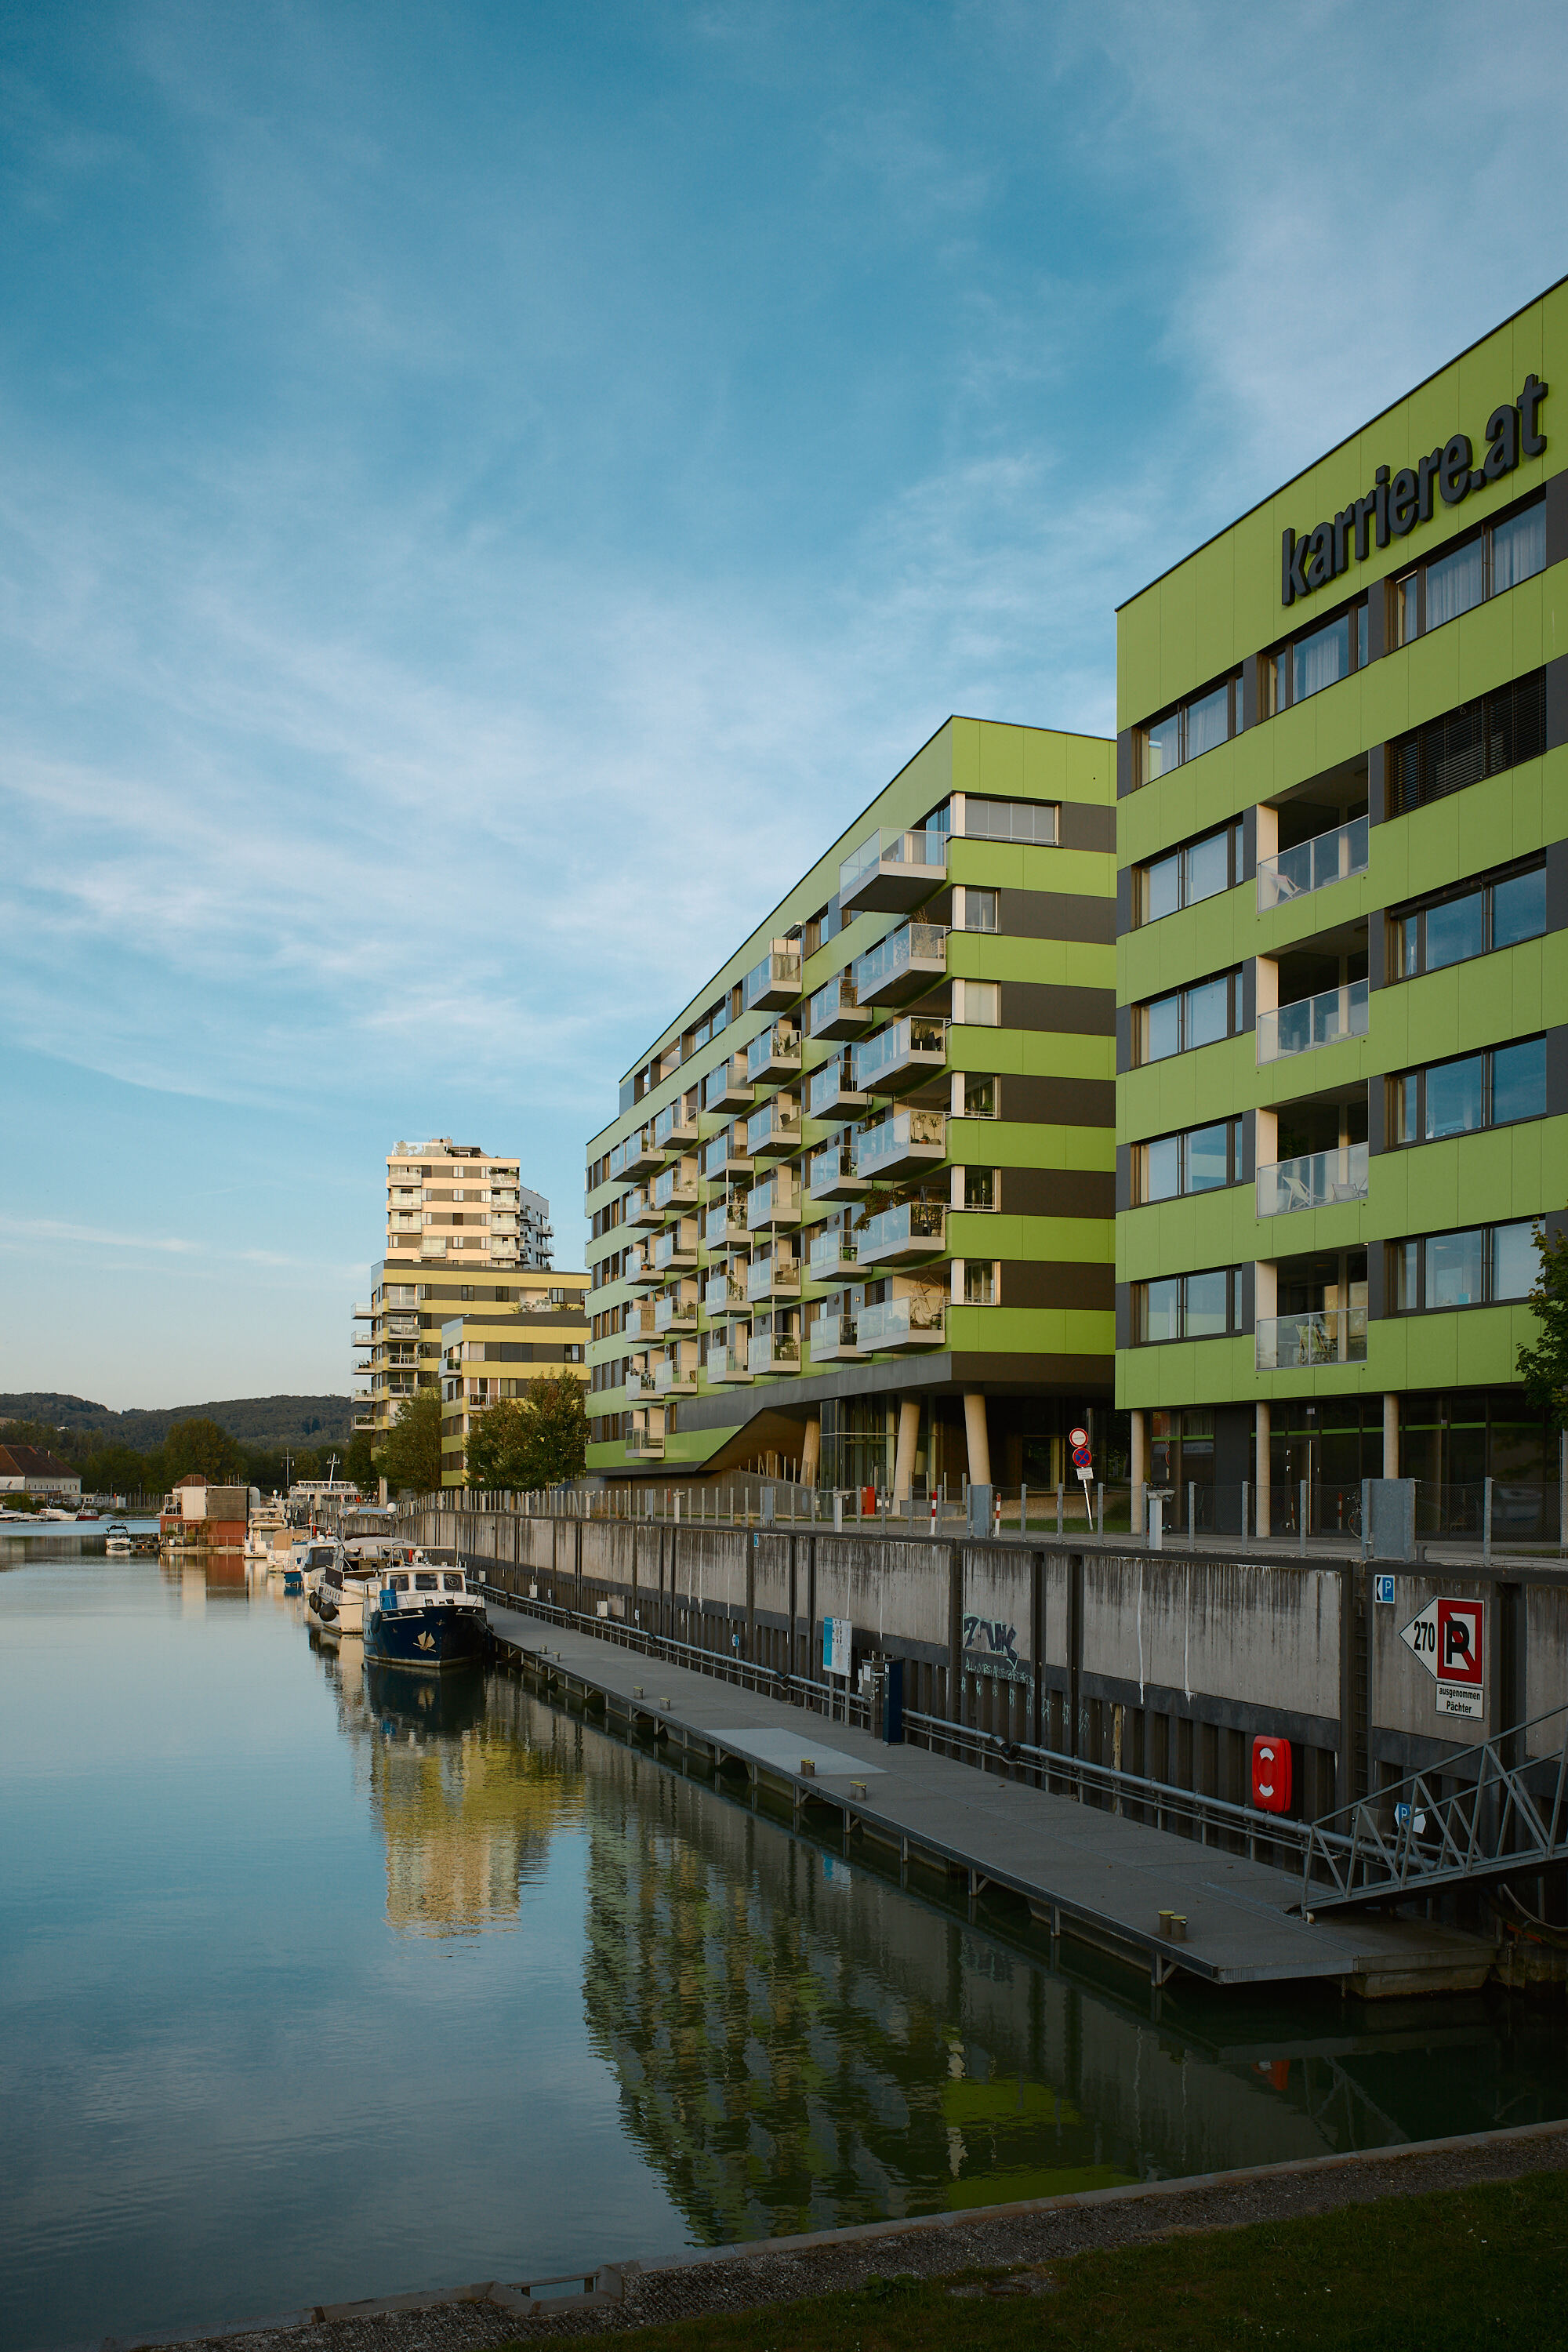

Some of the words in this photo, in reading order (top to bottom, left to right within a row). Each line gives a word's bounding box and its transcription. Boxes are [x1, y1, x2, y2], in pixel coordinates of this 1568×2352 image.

[1282, 374, 1548, 606] karriere.at
[1385, 1581, 1392, 1593] P
[1414, 1621, 1436, 1653] 270
[1439, 1687, 1481, 1700] ausgenommen
[1446, 1700, 1472, 1714] Pächter
